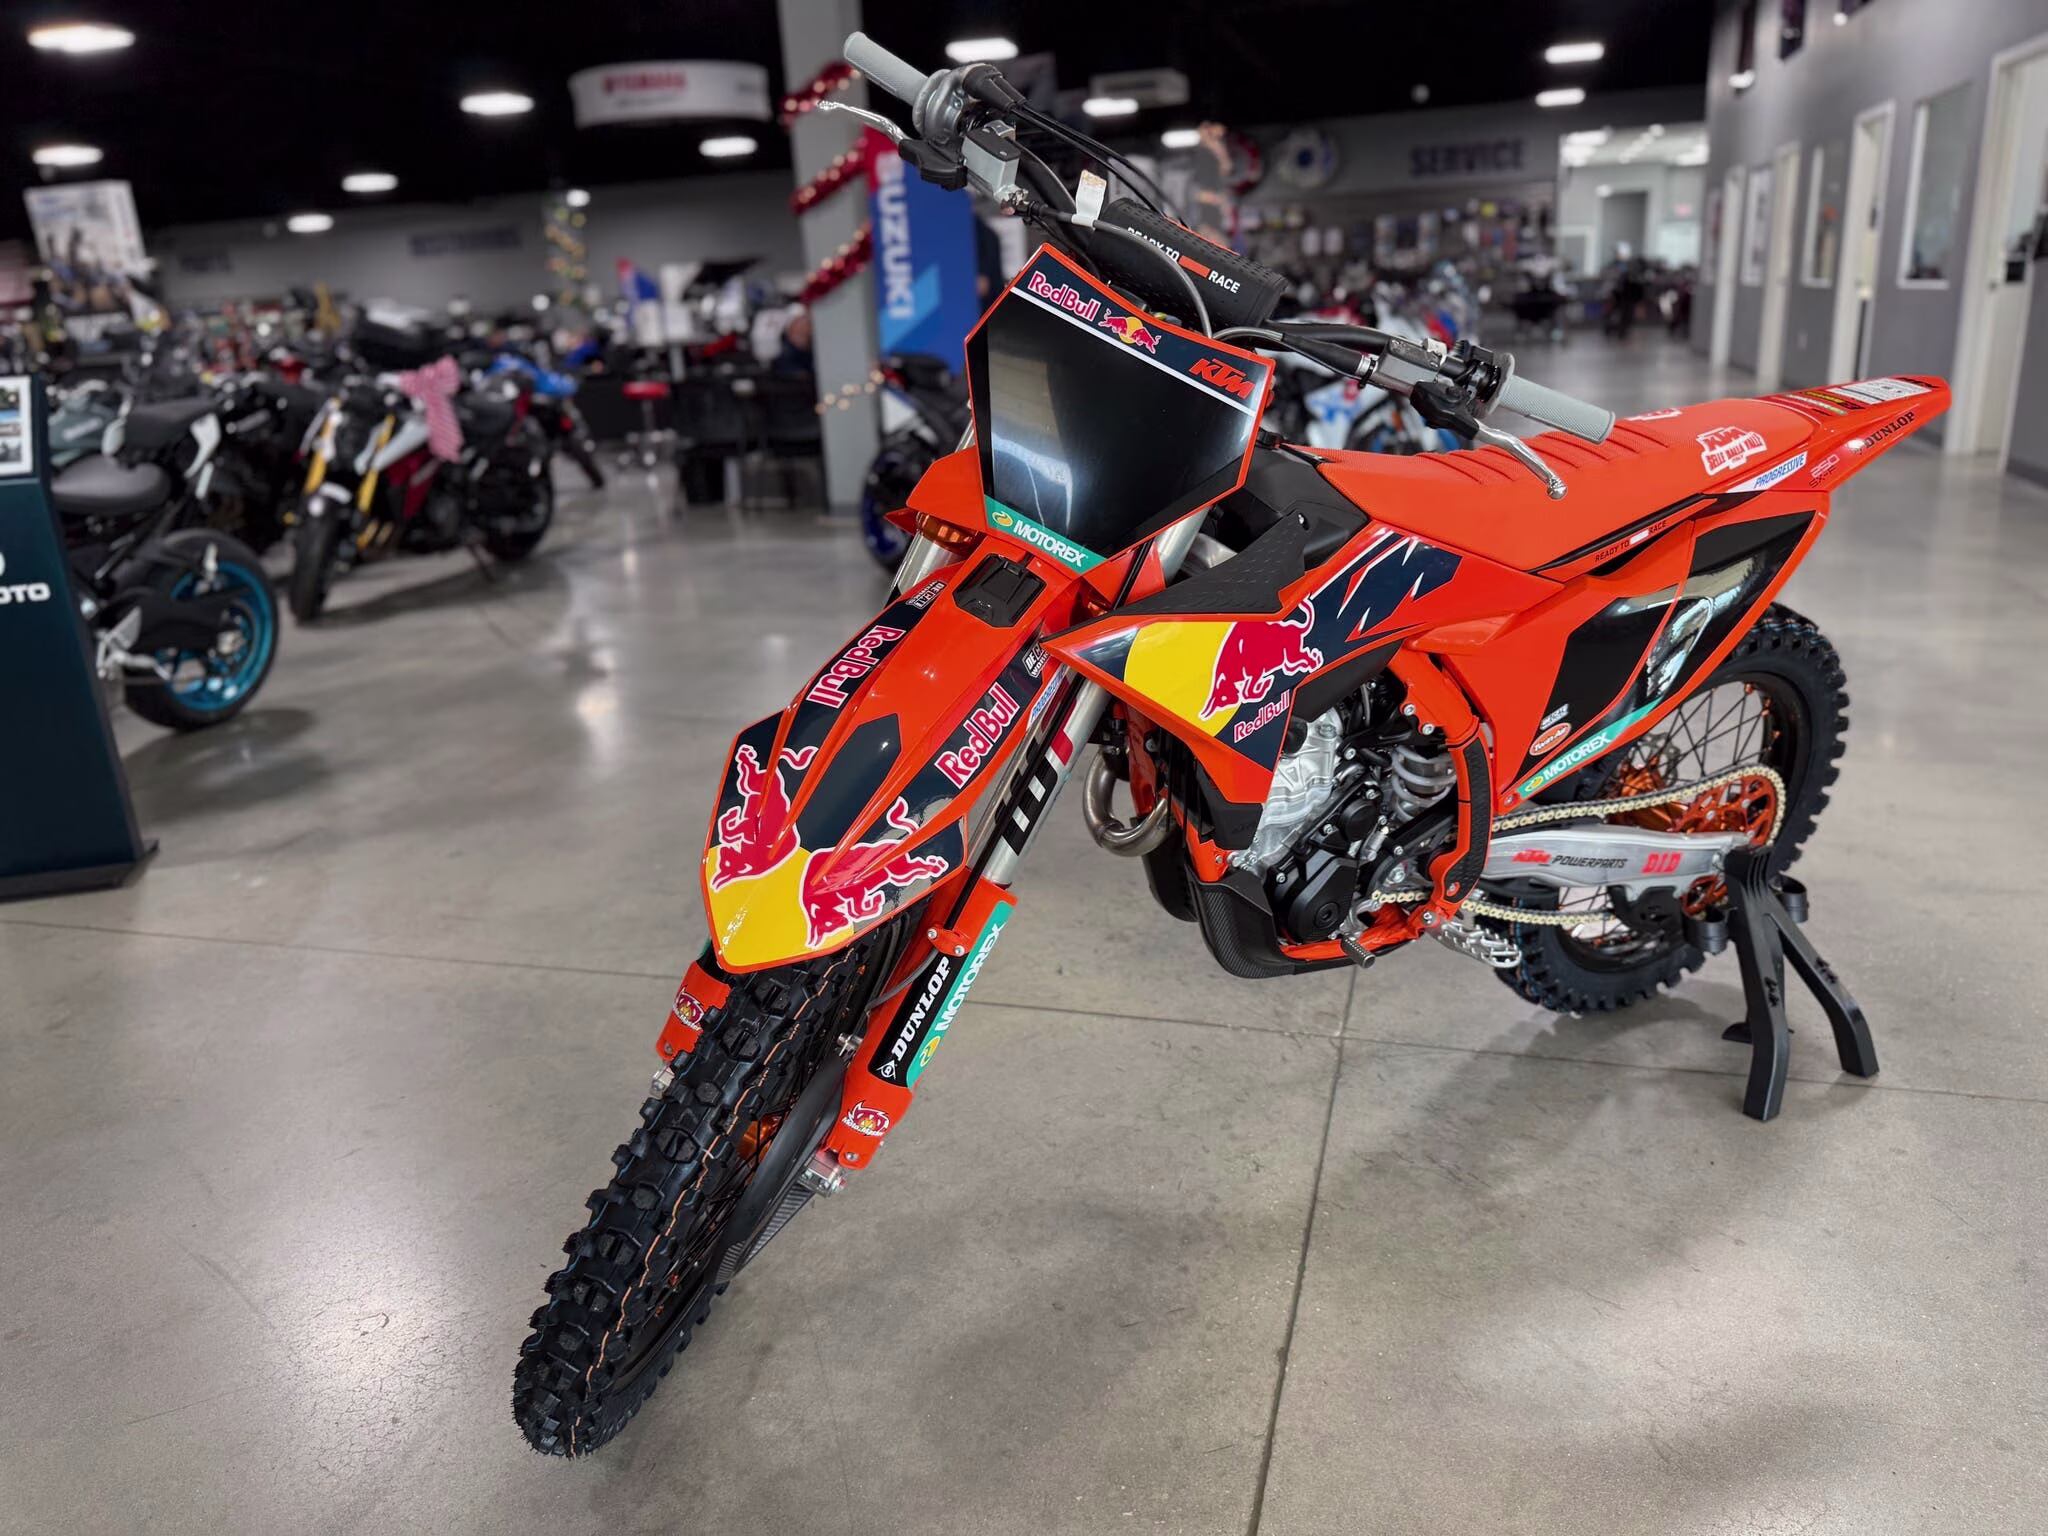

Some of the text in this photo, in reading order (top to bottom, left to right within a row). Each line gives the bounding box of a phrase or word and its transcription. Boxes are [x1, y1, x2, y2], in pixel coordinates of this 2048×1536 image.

[1208, 270, 1240, 293] RACE
[1188, 358, 1255, 399] KTM
[1865, 411, 1916, 448] DUNLOP
[1754, 454, 1805, 489] PROGRESSIVE
[1810, 454, 1840, 478] 250
[1013, 521, 1087, 567] MOTOREX
[1595, 520, 1667, 562] READY TO RACE
[1543, 732, 1612, 780] MOTOREX
[1551, 855, 1628, 868] POWERPARTS
[935, 922, 1007, 1031] MOTOREX
[891, 956, 951, 1061] DUNLOP
